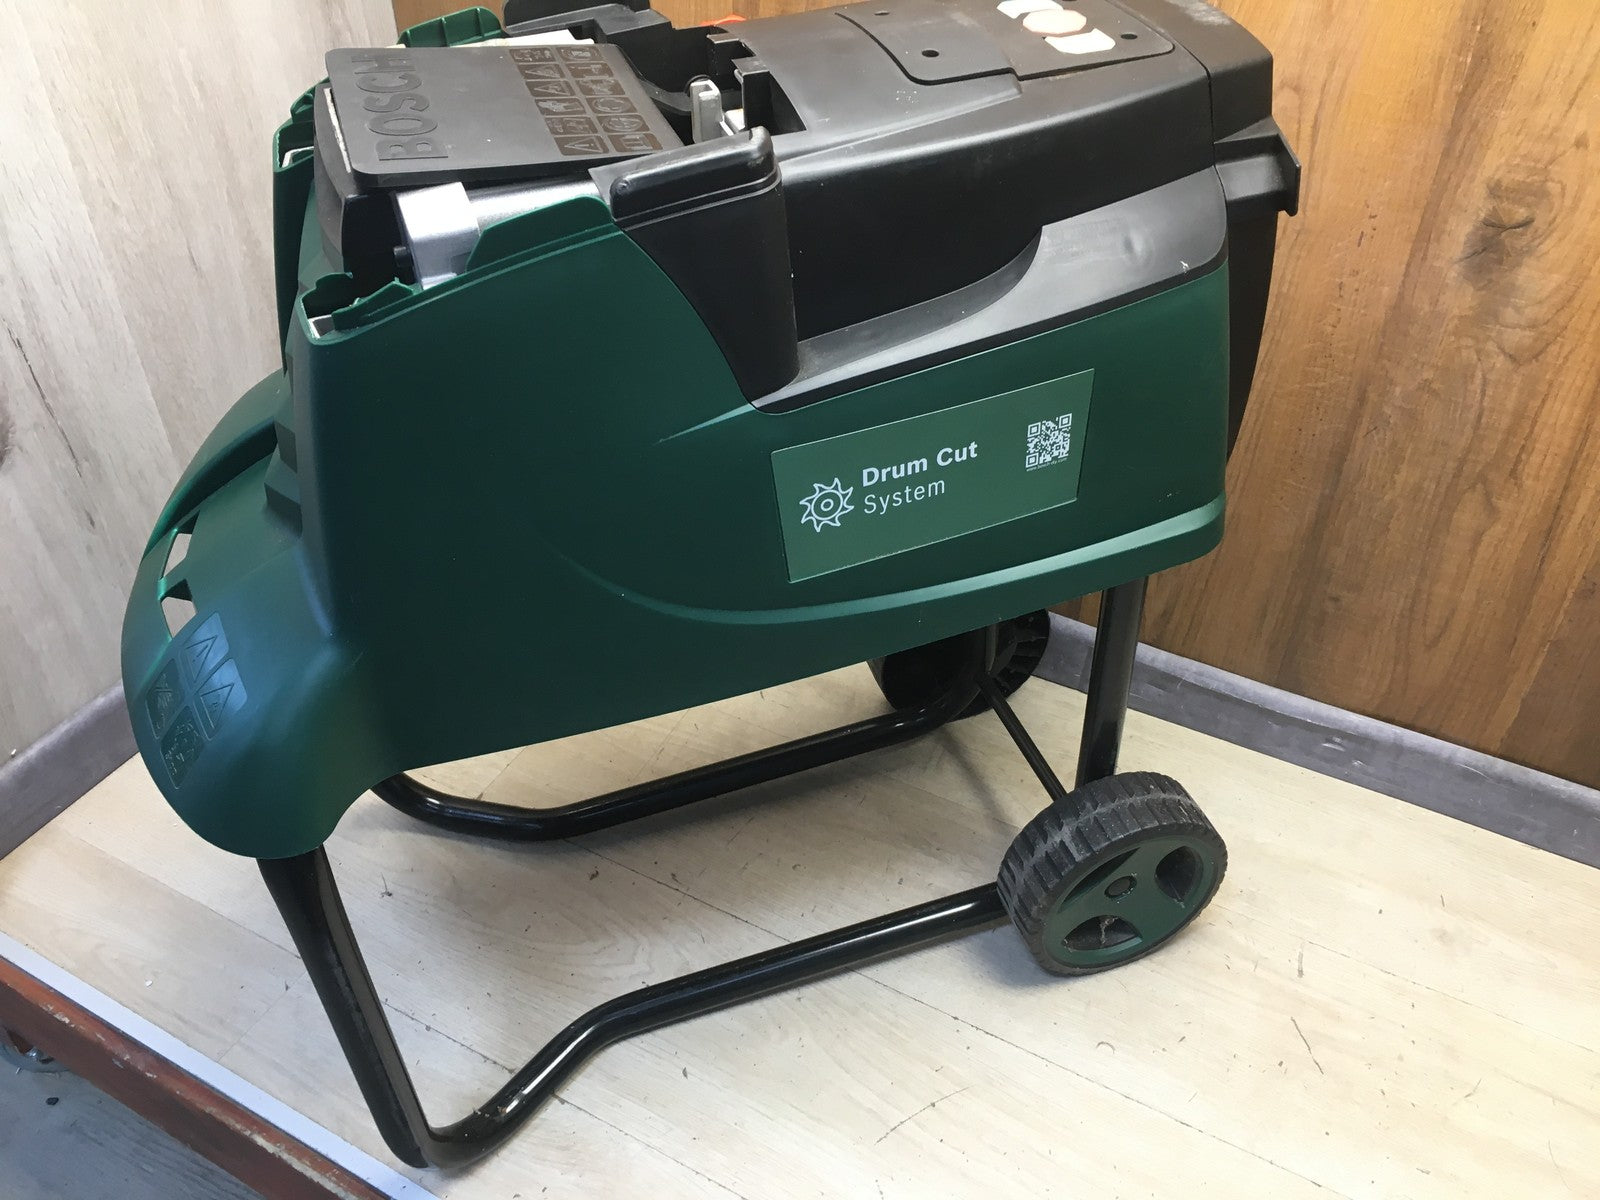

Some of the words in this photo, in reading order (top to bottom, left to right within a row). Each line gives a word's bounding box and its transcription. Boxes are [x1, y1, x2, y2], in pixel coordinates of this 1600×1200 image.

[350, 54, 449, 161] BOSCH
[862, 457, 928, 487] Drum
[936, 441, 978, 467] Cut
[863, 479, 945, 514] System
